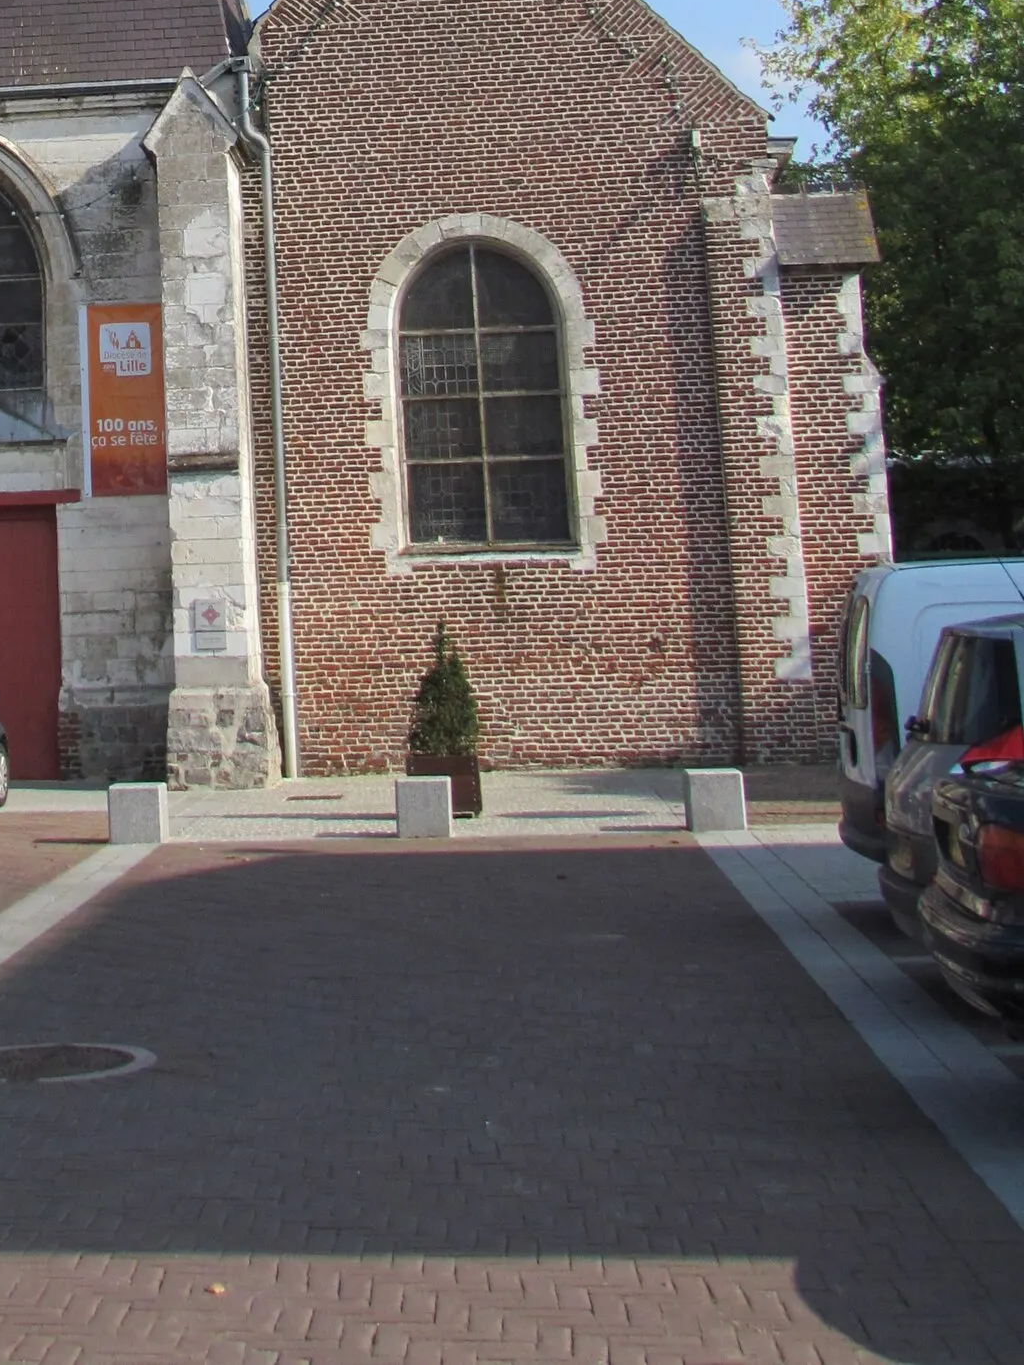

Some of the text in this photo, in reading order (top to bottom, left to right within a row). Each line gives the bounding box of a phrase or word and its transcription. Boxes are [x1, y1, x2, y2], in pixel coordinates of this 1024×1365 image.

[120, 360, 146, 372] Lille
[97, 418, 158, 432] 100 ans,
[91, 436, 106, 449] ça
[110, 436, 126, 446] se
[130, 432, 157, 446] fête
